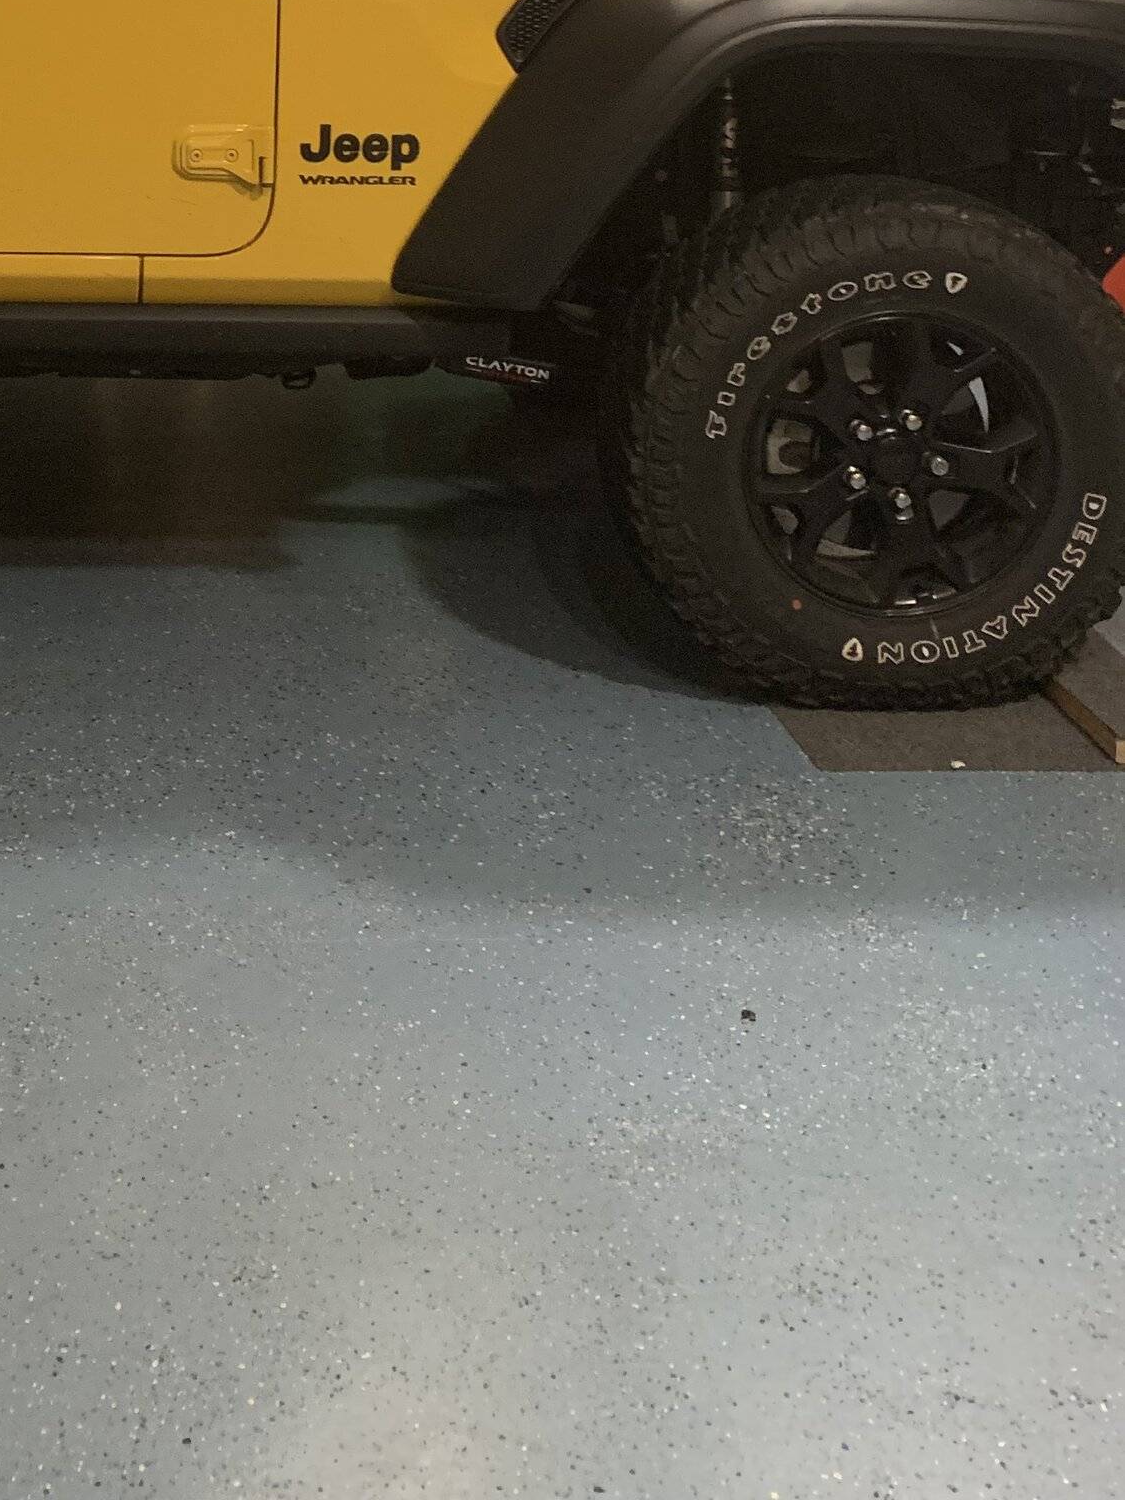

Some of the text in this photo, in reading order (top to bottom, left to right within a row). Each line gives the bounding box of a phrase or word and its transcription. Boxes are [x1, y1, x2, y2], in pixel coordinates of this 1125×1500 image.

[300, 124, 420, 171] Jeep
[299, 175, 417, 186] WRANGLER
[465, 356, 550, 380] CLAYTON
[877, 493, 1107, 664] DESTINATION
